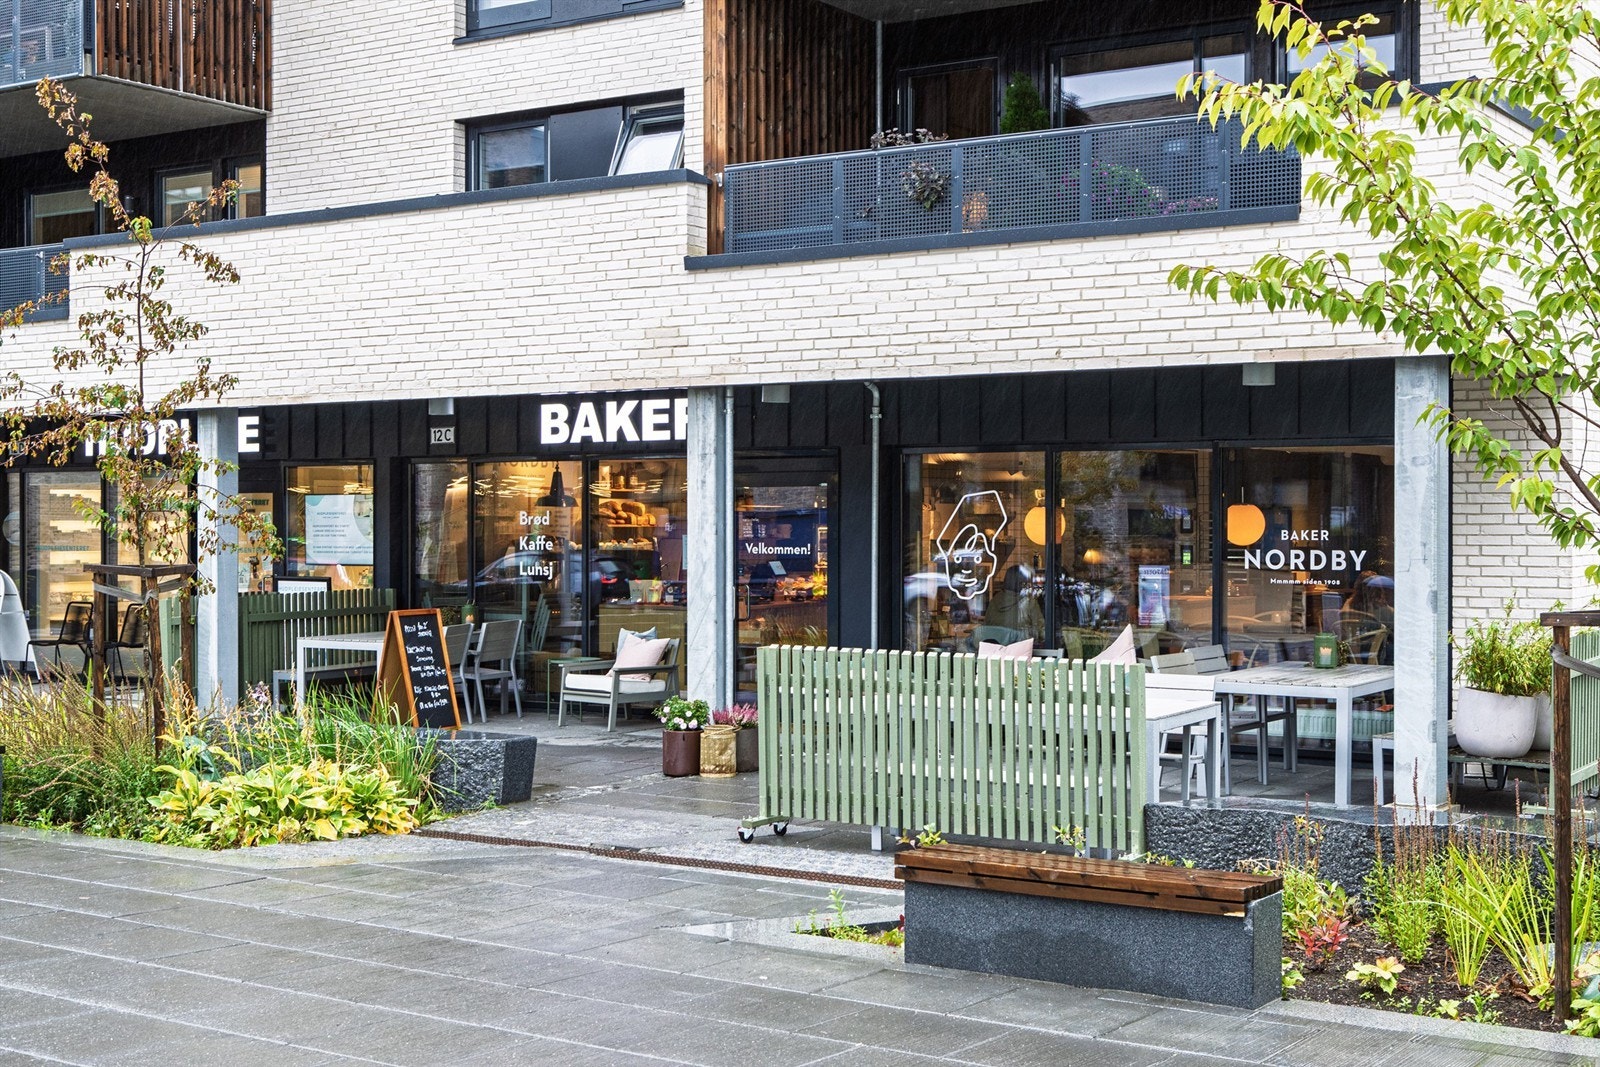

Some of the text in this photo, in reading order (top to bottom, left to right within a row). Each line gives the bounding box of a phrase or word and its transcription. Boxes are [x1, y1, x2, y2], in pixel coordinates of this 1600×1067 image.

[519, 511, 550, 526] Brød
[1281, 530, 1329, 541] BAKER
[519, 536, 554, 551] Kaffe
[745, 543, 811, 555] Velkommen!
[1244, 549, 1367, 571] NORDBY
[519, 562, 553, 580] Lunsj
